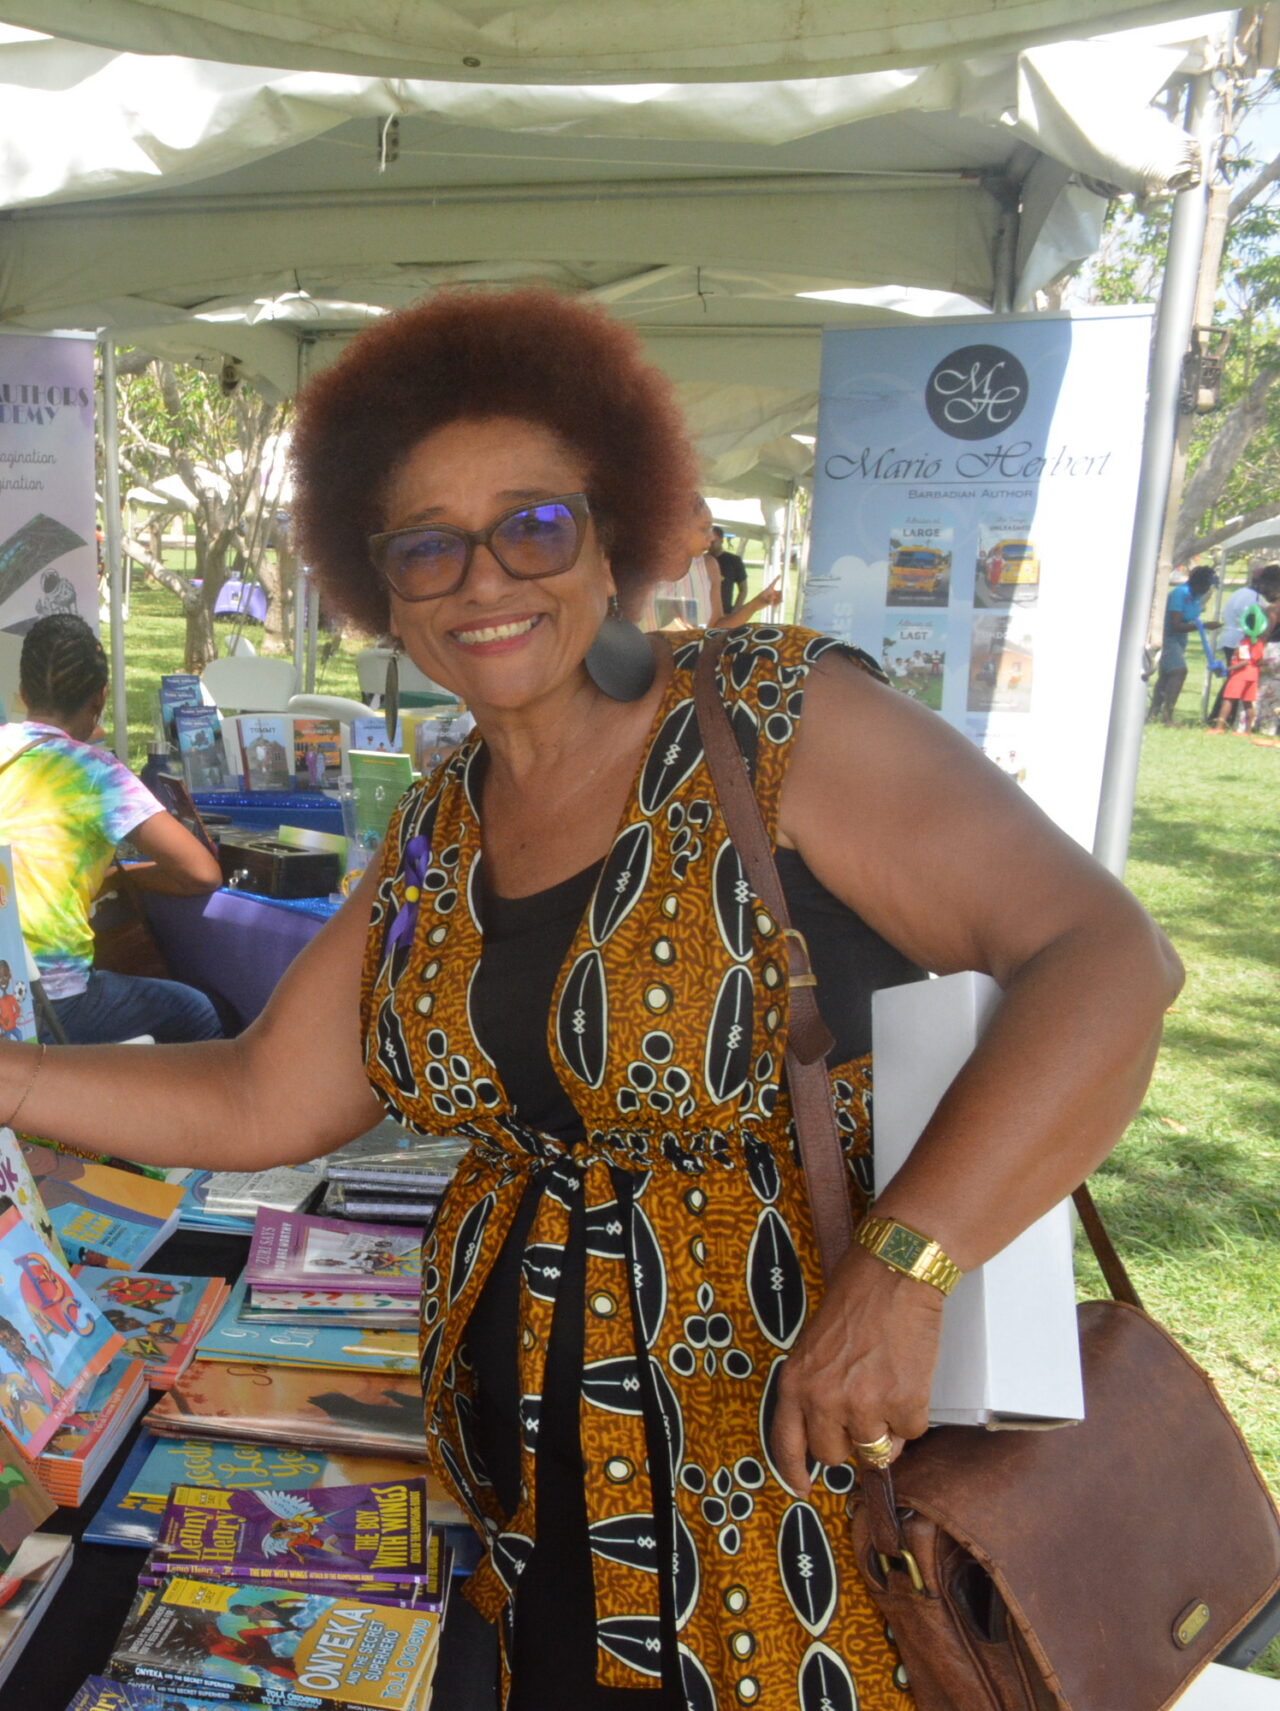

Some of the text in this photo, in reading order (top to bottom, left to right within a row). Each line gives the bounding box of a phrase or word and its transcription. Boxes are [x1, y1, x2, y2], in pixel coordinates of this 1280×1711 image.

[825, 441, 1112, 480] Mario Herbert
[908, 489, 1033, 500] BARBADIAN AUTHOR
[903, 528, 940, 537] LARGE
[900, 632, 928, 640] LAST
[168, 1506, 214, 1562] Lenny
[200, 1506, 247, 1562] Henry
[354, 1509, 380, 1551] THE BOY
[369, 1484, 409, 1569] WITH WINGS
[297, 1605, 375, 1692] ONYEKA
[345, 1621, 385, 1686] AND THE SECRET
[364, 1629, 400, 1684] SUPERHERO
[396, 1618, 431, 1668] OKOGWU
[134, 1666, 163, 1680] ONYEKA
